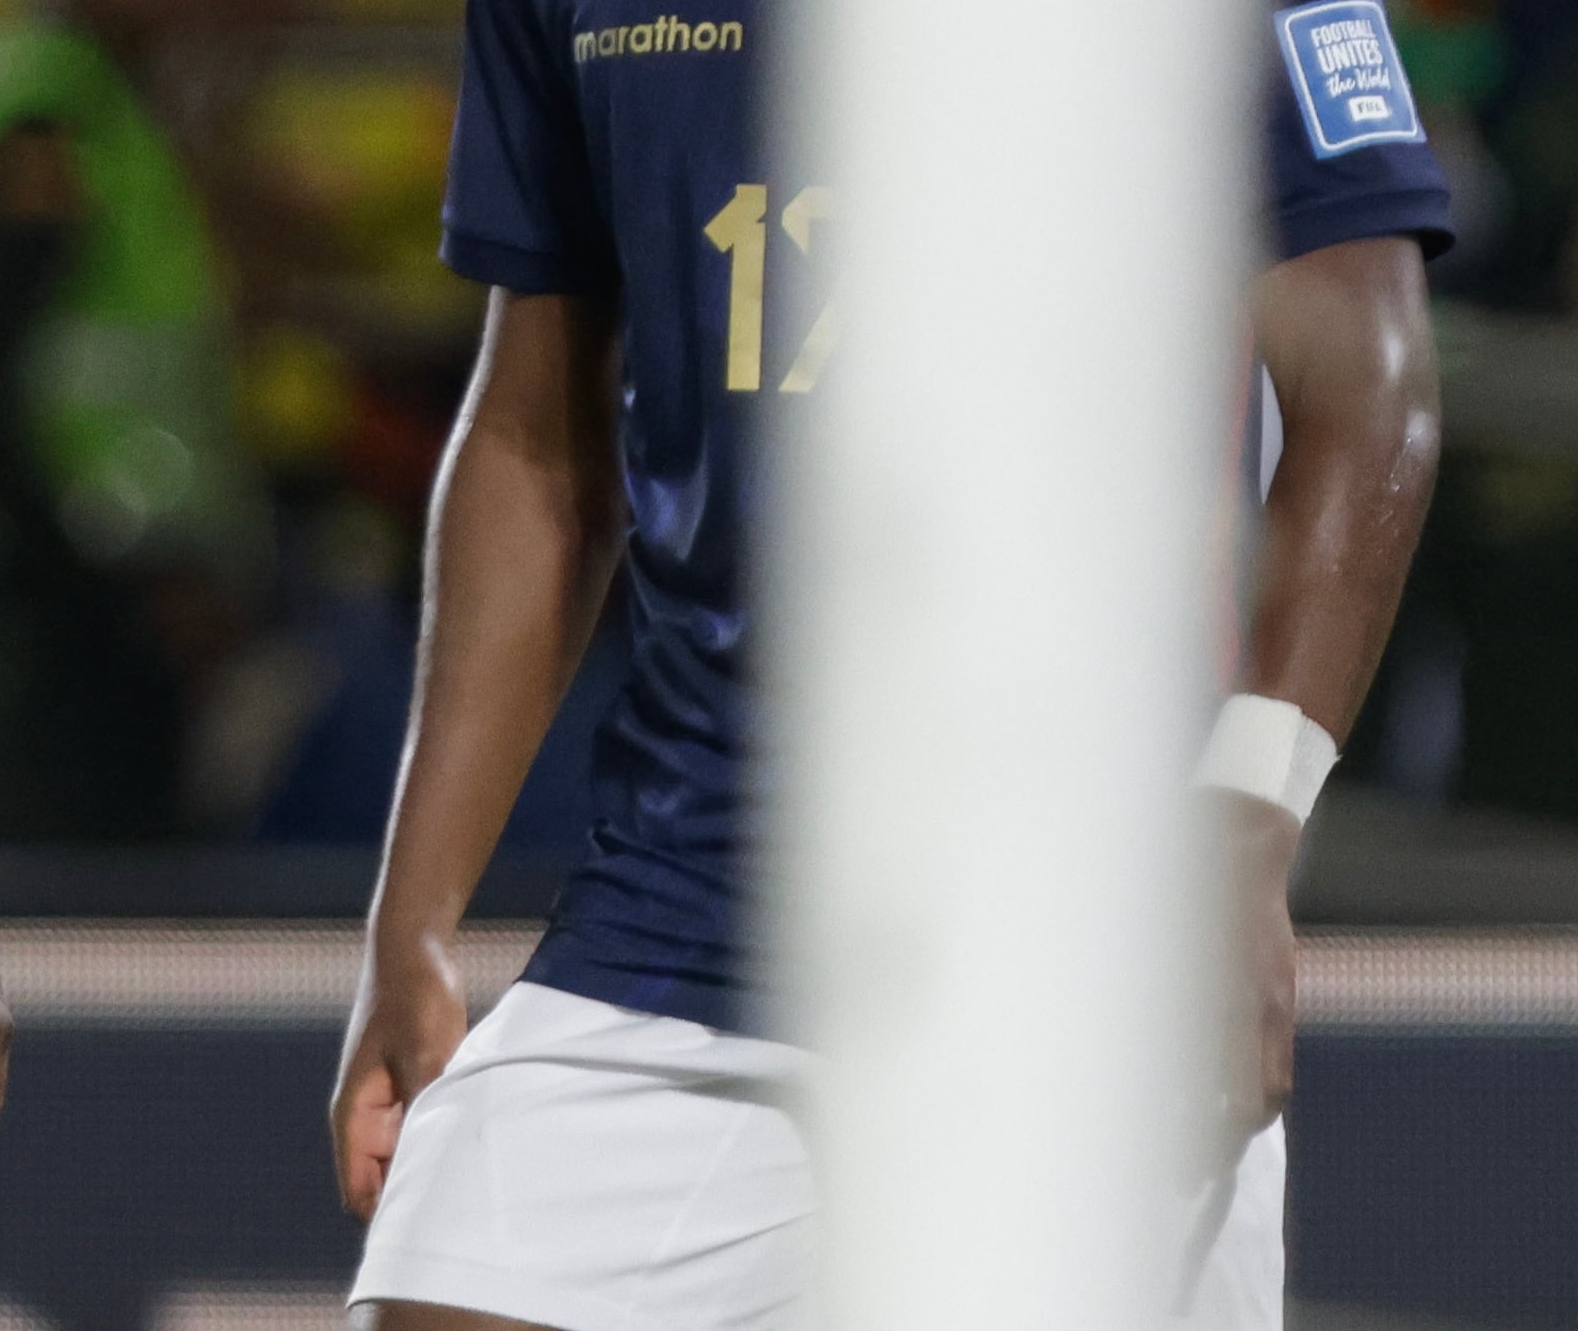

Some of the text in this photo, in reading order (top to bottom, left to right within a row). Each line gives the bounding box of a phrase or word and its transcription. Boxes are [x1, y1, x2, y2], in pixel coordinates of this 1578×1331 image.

[573, 14, 744, 63] marathon
[1310, 19, 1377, 47] FOOTBALL
[1317, 38, 1384, 74] UNITES
[1325, 73, 1356, 98] the
